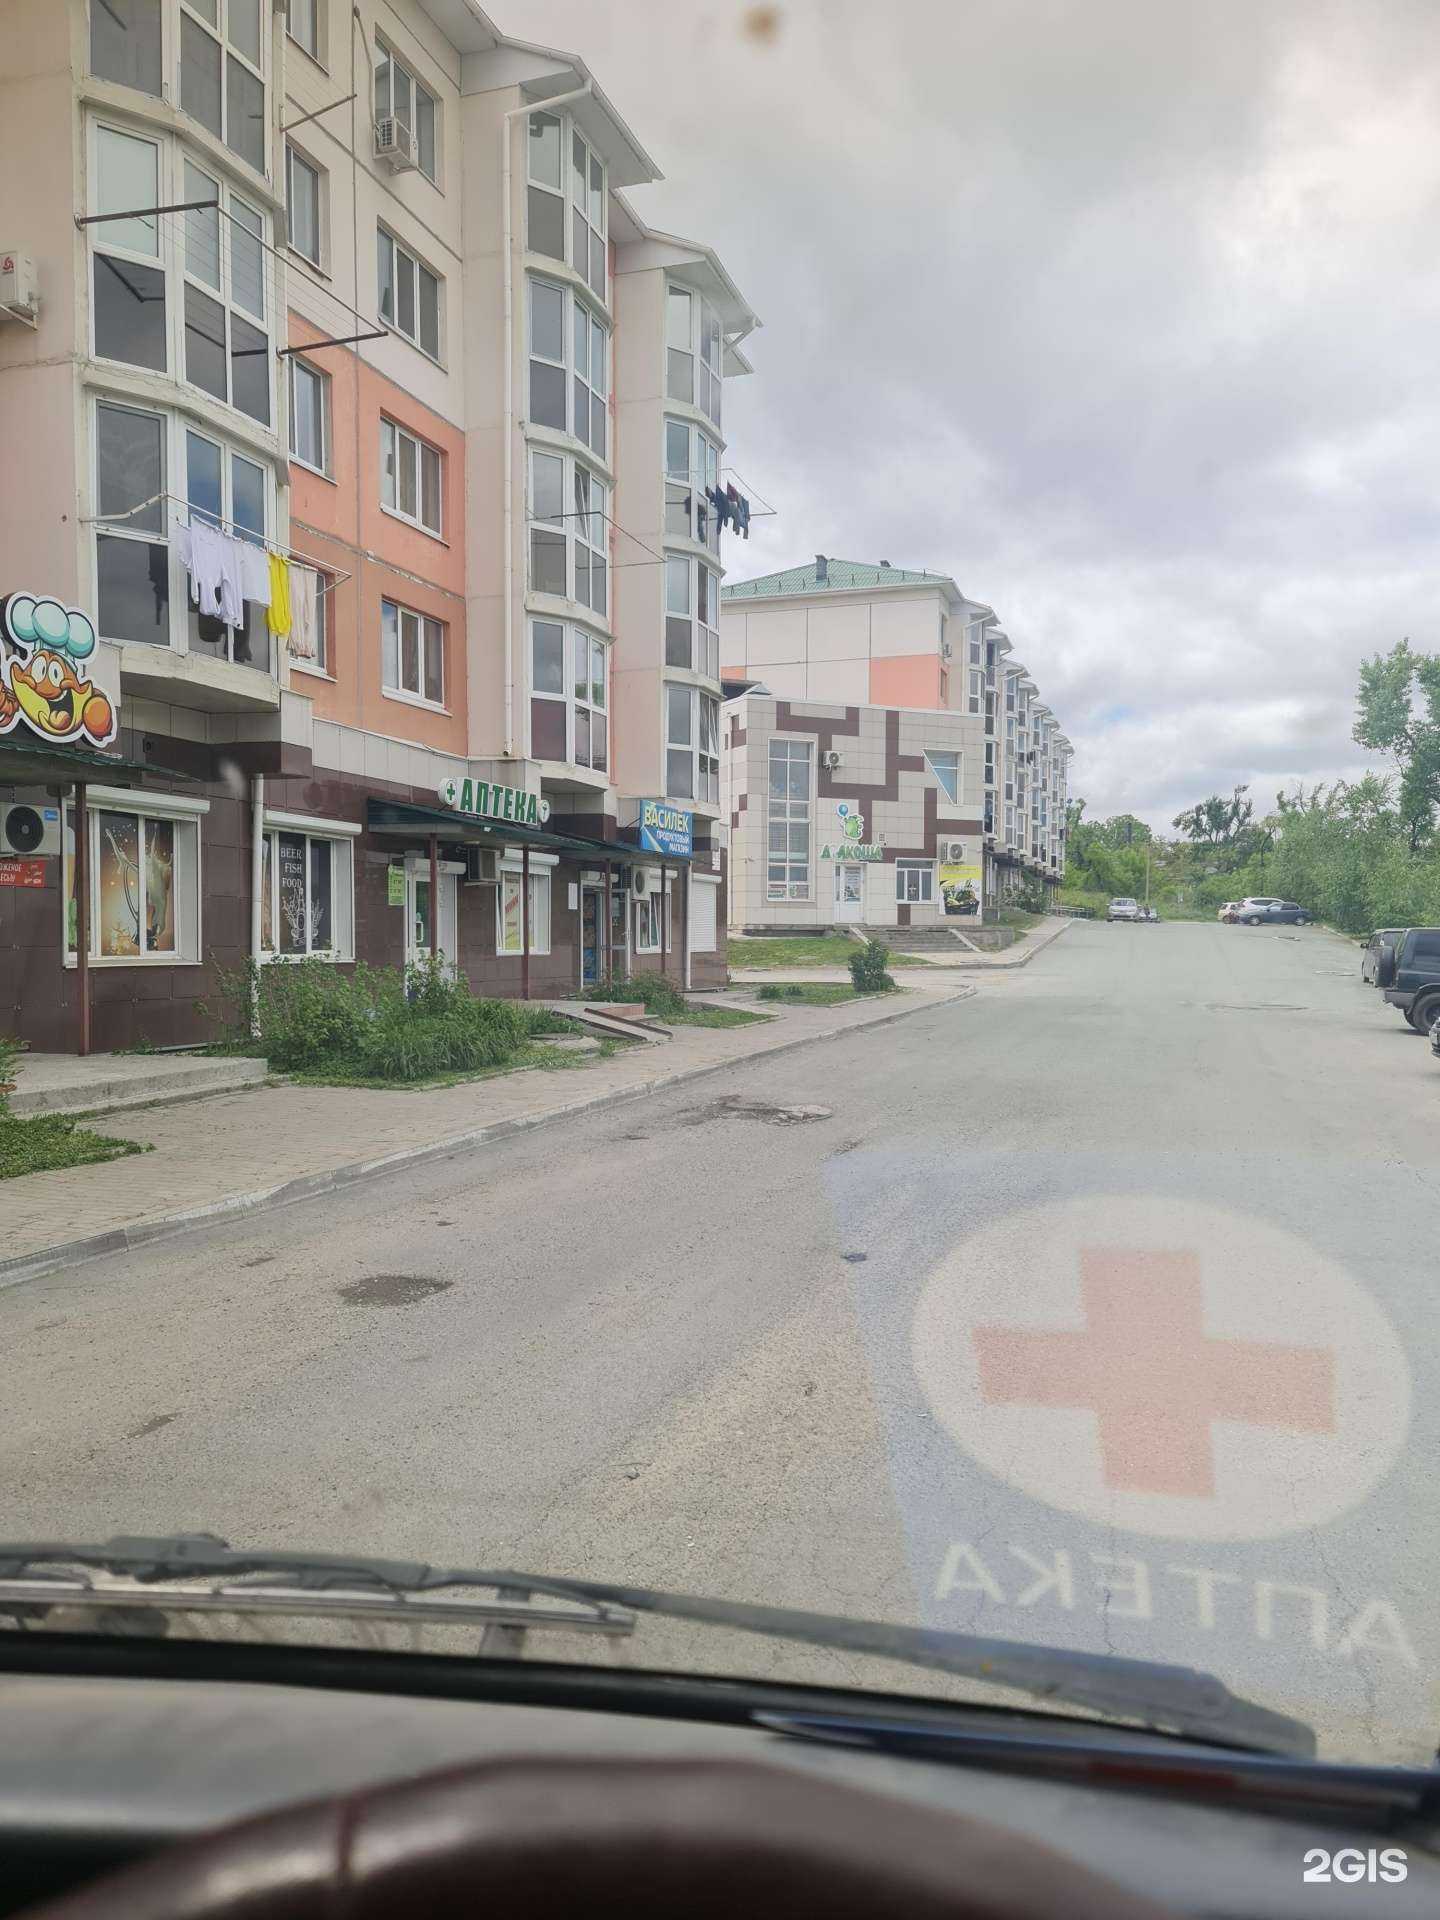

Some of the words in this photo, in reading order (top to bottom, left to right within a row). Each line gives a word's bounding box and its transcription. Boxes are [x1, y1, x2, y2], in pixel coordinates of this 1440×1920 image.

[460, 779, 537, 824] АПТЕКА
[644, 804, 689, 833] ВАСИЛЕК
[280, 847, 302, 859] BEER
[284, 862, 302, 873] FISH
[281, 877, 302, 888] FOOD
